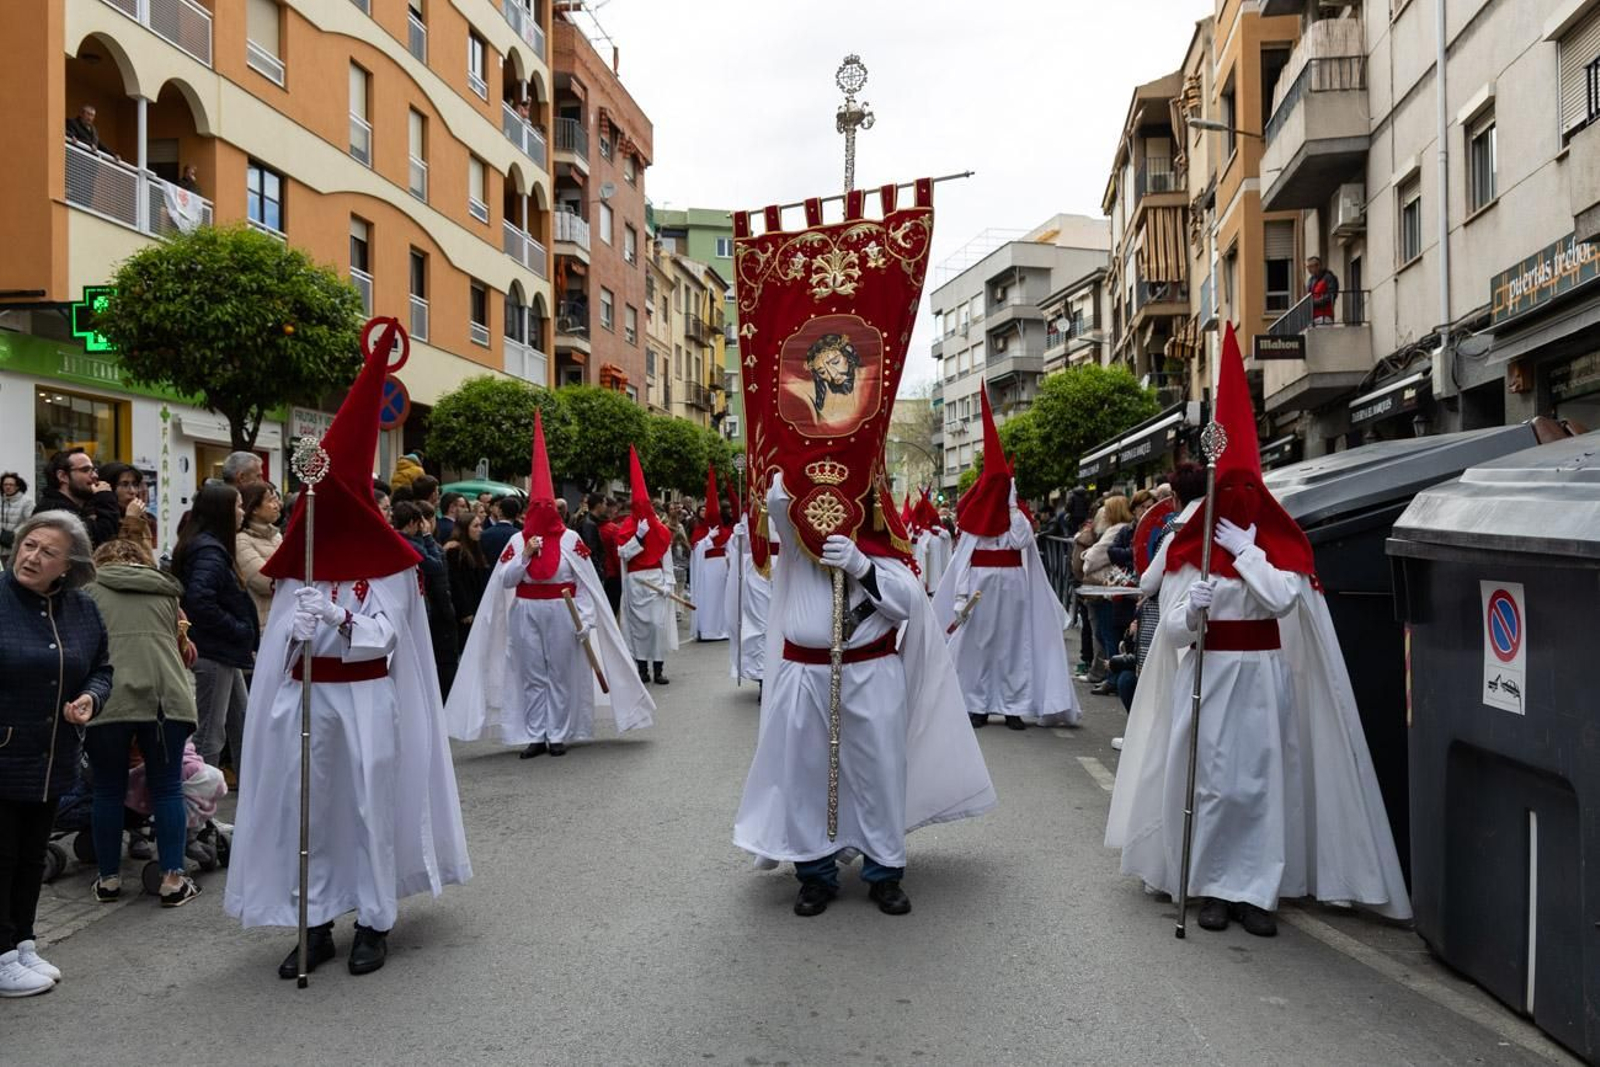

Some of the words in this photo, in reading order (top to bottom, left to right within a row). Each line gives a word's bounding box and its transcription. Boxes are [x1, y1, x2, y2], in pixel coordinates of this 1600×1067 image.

[1508, 260, 1552, 315] puertas
[1259, 339, 1300, 350] Mahou
[294, 409, 317, 423] FRUTAS
